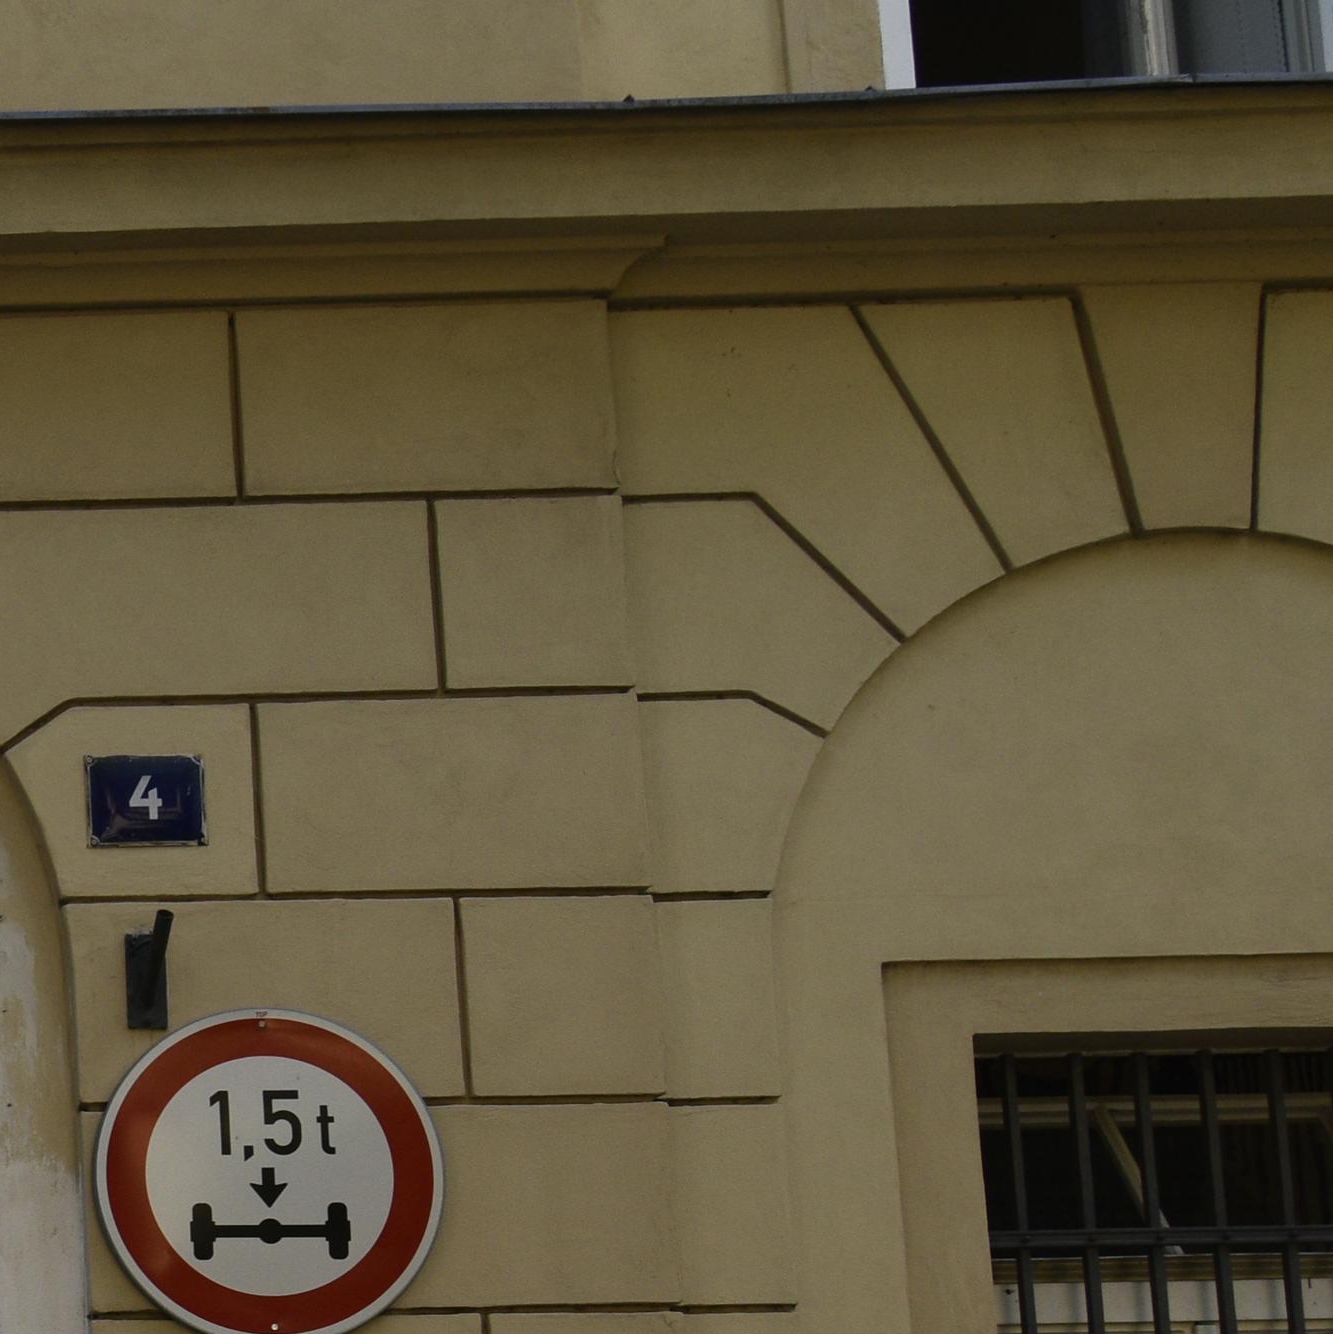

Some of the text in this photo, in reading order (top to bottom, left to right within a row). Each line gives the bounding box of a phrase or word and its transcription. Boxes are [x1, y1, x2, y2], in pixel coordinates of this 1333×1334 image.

[129, 775, 163, 820] 4
[209, 1089, 336, 1162] 1,5 t
